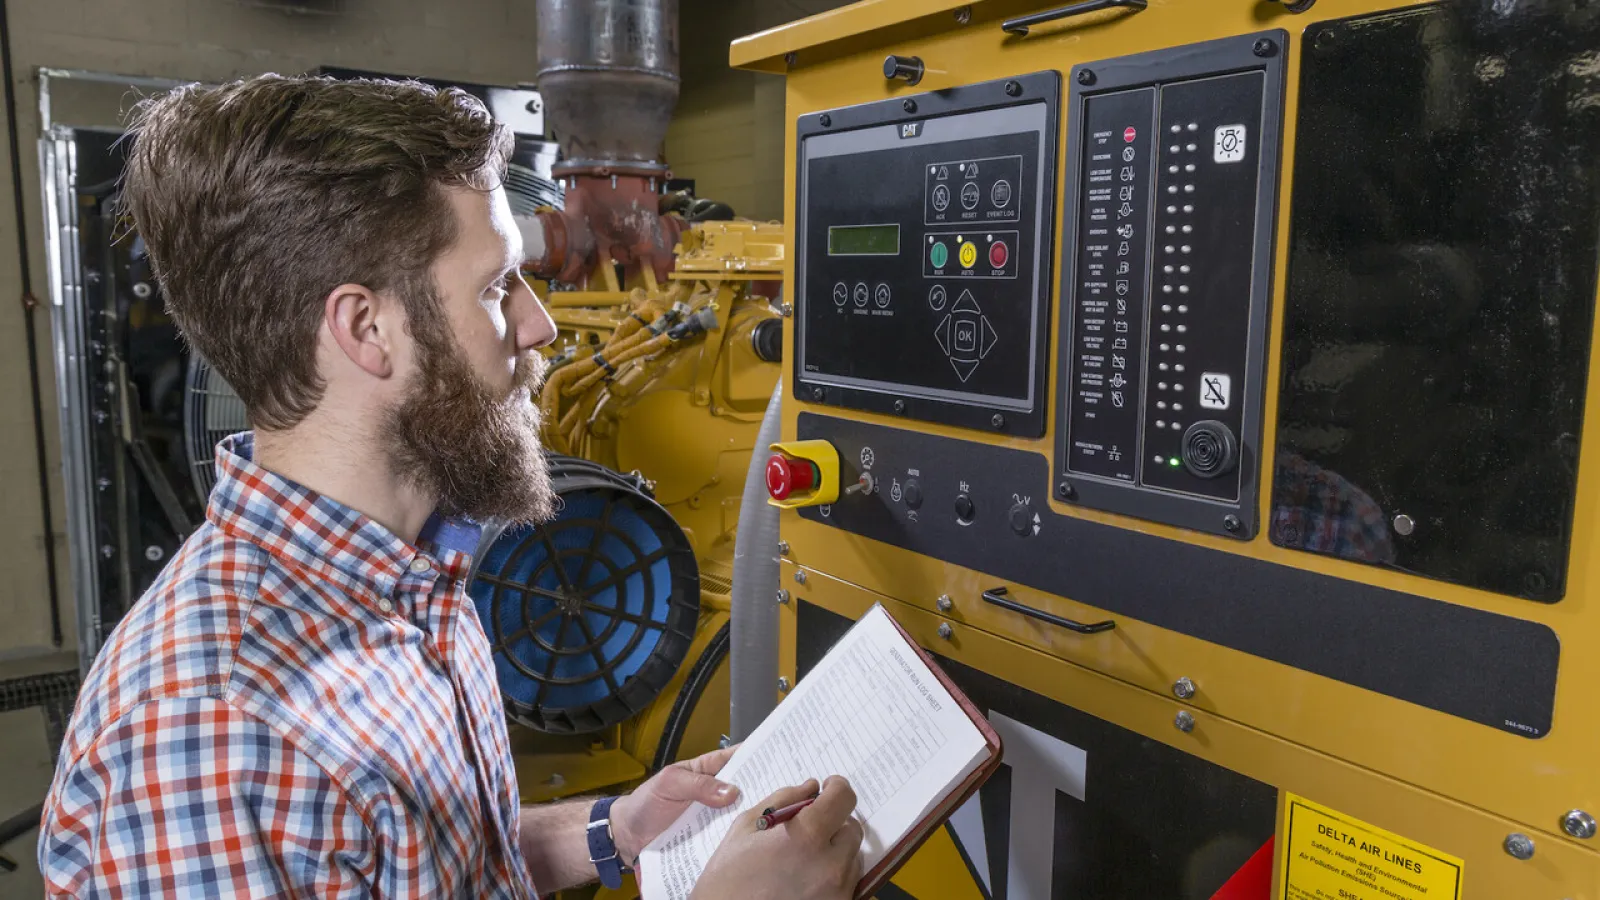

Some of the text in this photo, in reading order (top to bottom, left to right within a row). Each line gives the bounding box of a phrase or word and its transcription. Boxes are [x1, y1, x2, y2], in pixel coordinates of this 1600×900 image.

[903, 124, 918, 137] CAT
[958, 331, 972, 342] OK
[908, 468, 919, 476] AUTO
[960, 481, 969, 493] Hz
[889, 647, 913, 675] GENERATOR
[917, 683, 929, 697] LOG
[926, 694, 942, 712] SHEET
[1318, 824, 1422, 874] DELTA AIR LINES
[1299, 852, 1309, 860] Air
[1310, 856, 1340, 874] Pollution
[1341, 869, 1378, 891] Emissions
[1311, 840, 1428, 894] Safety, Health and Environmental
[1355, 868, 1377, 882] (SHE)
